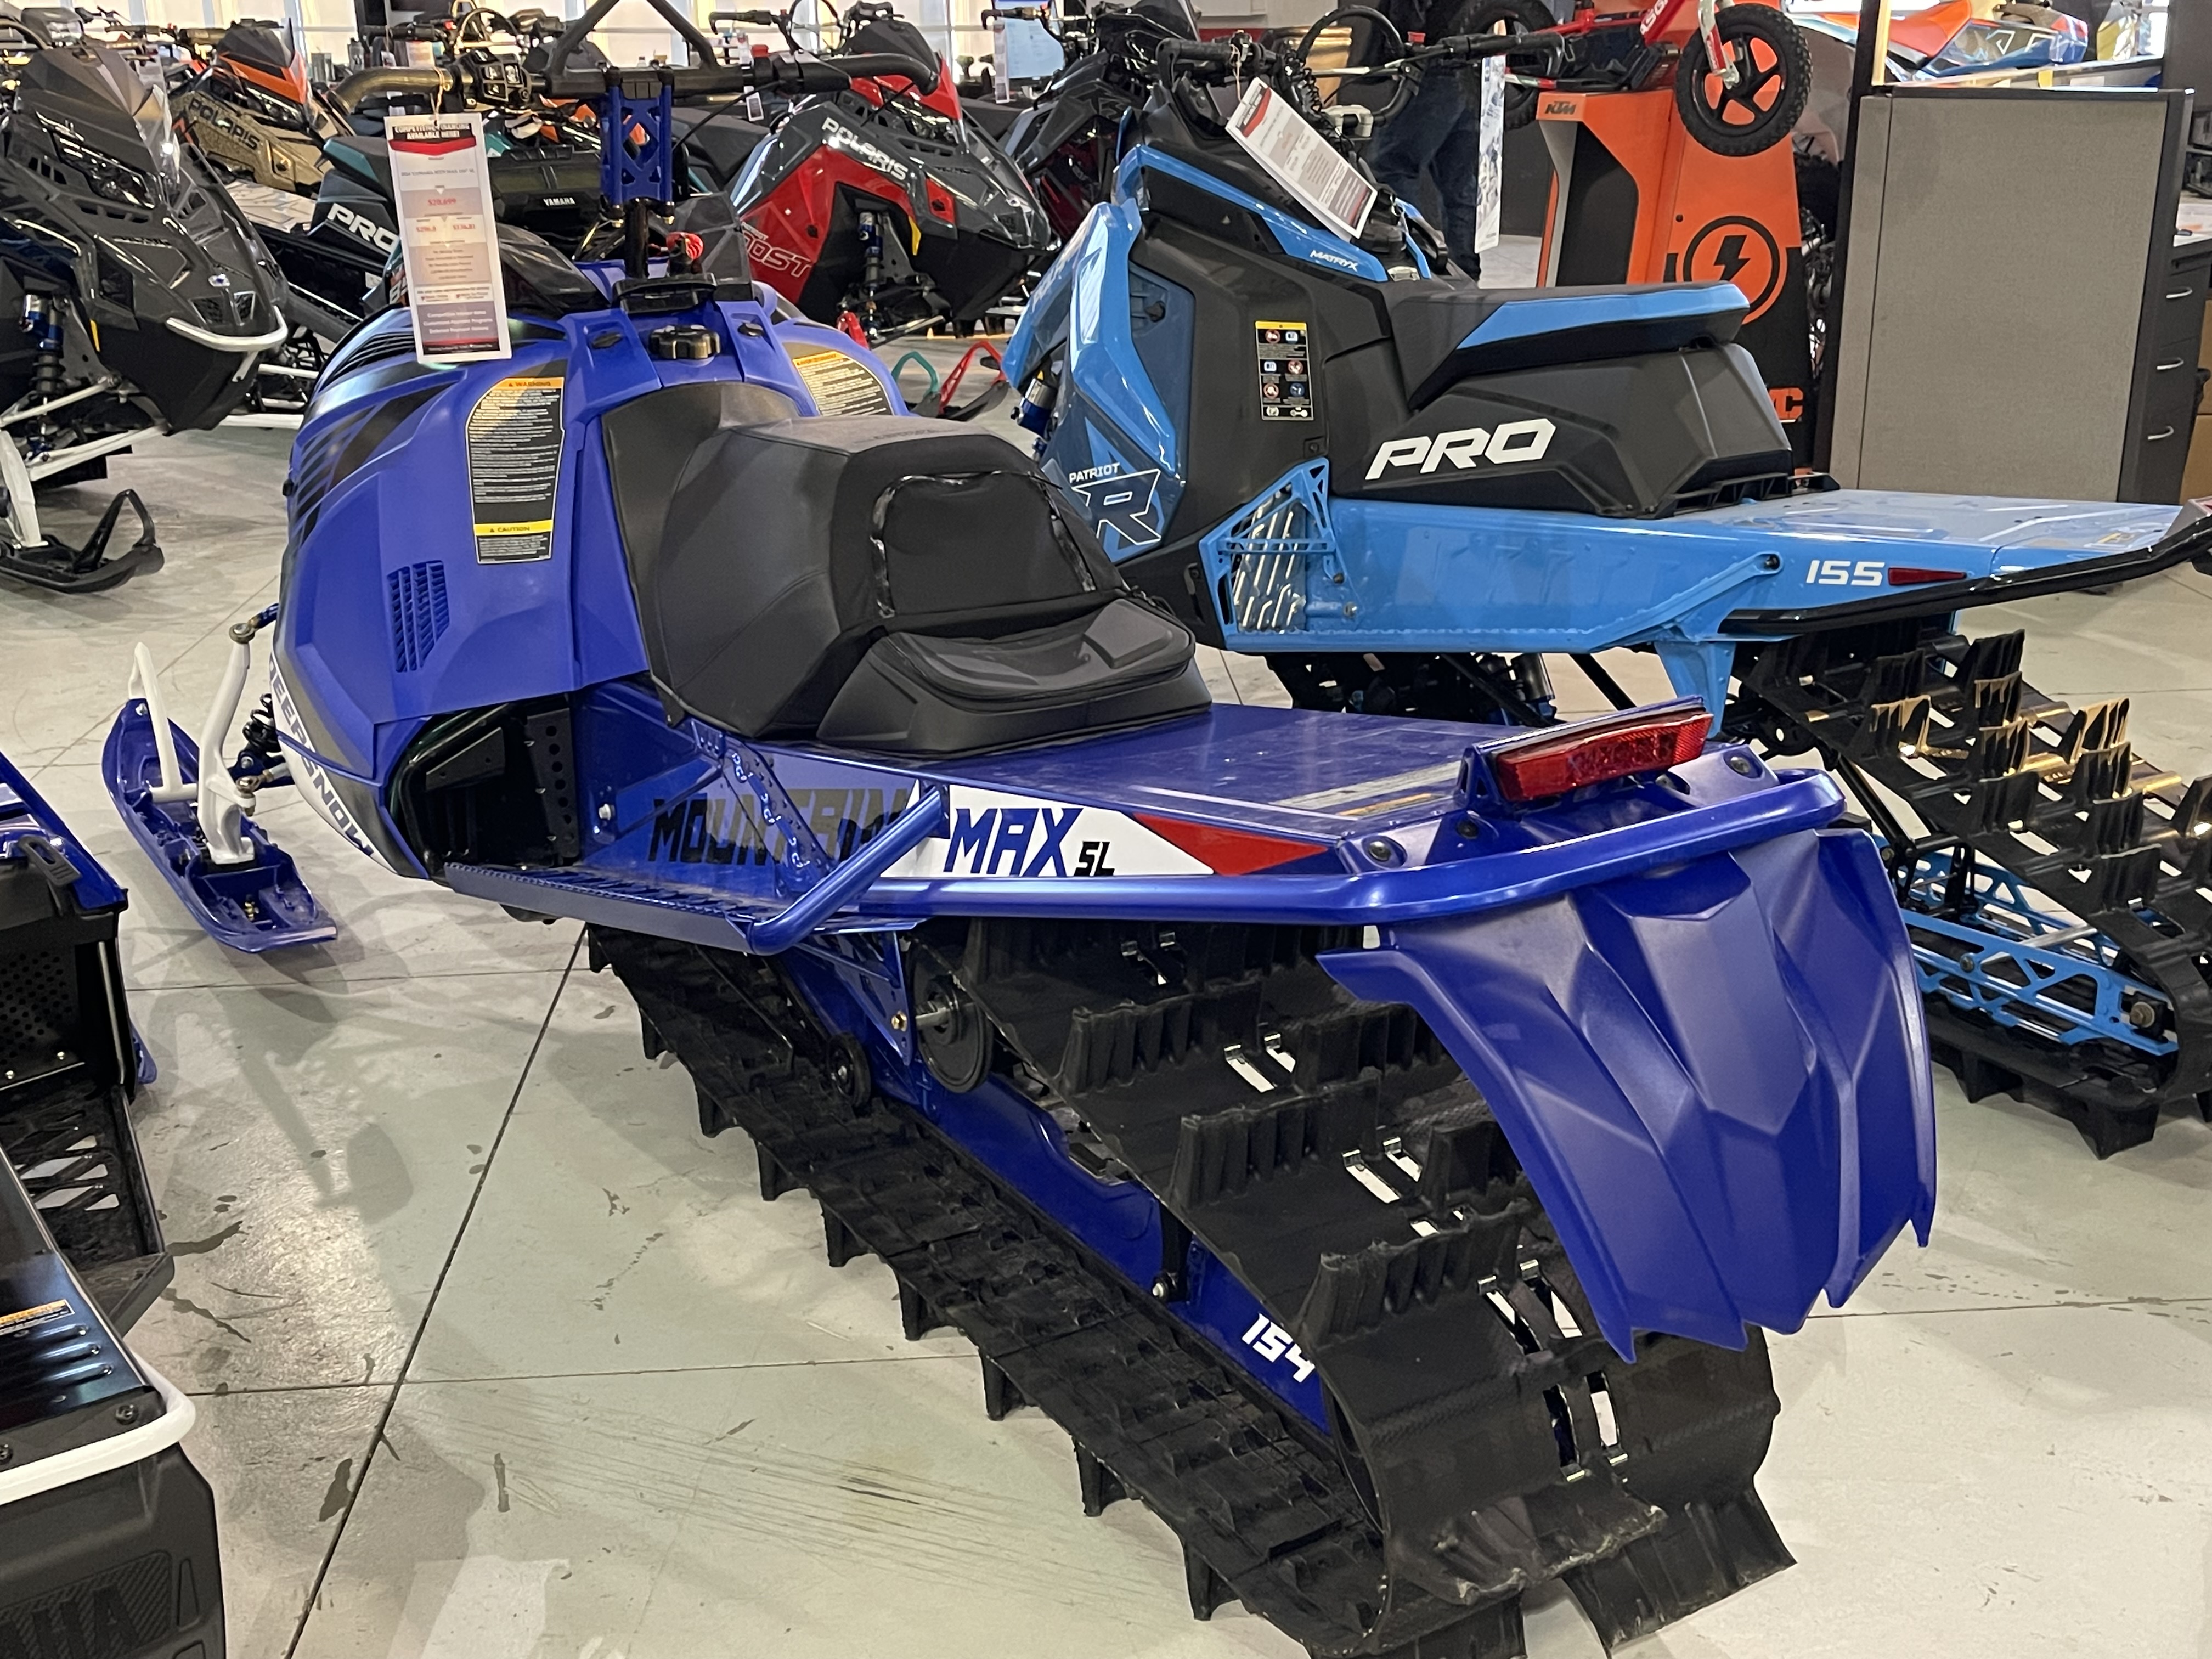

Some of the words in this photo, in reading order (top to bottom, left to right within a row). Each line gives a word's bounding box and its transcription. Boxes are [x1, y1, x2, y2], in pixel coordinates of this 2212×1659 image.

[189, 98, 260, 151] POLARIS
[1544, 101, 1576, 115] KTM
[821, 117, 909, 180] POLARIS
[543, 197, 575, 206] YAMAHA
[327, 202, 400, 253] PRO
[1310, 250, 1358, 273] MATRYX
[1069, 462, 1120, 483] PATRIOT
[1365, 418, 1556, 480] PRO
[1806, 560, 1886, 586] 155
[943, 808, 1084, 877] MAX
[1074, 840, 1115, 877] SL
[1242, 1312, 1316, 1383] 154
